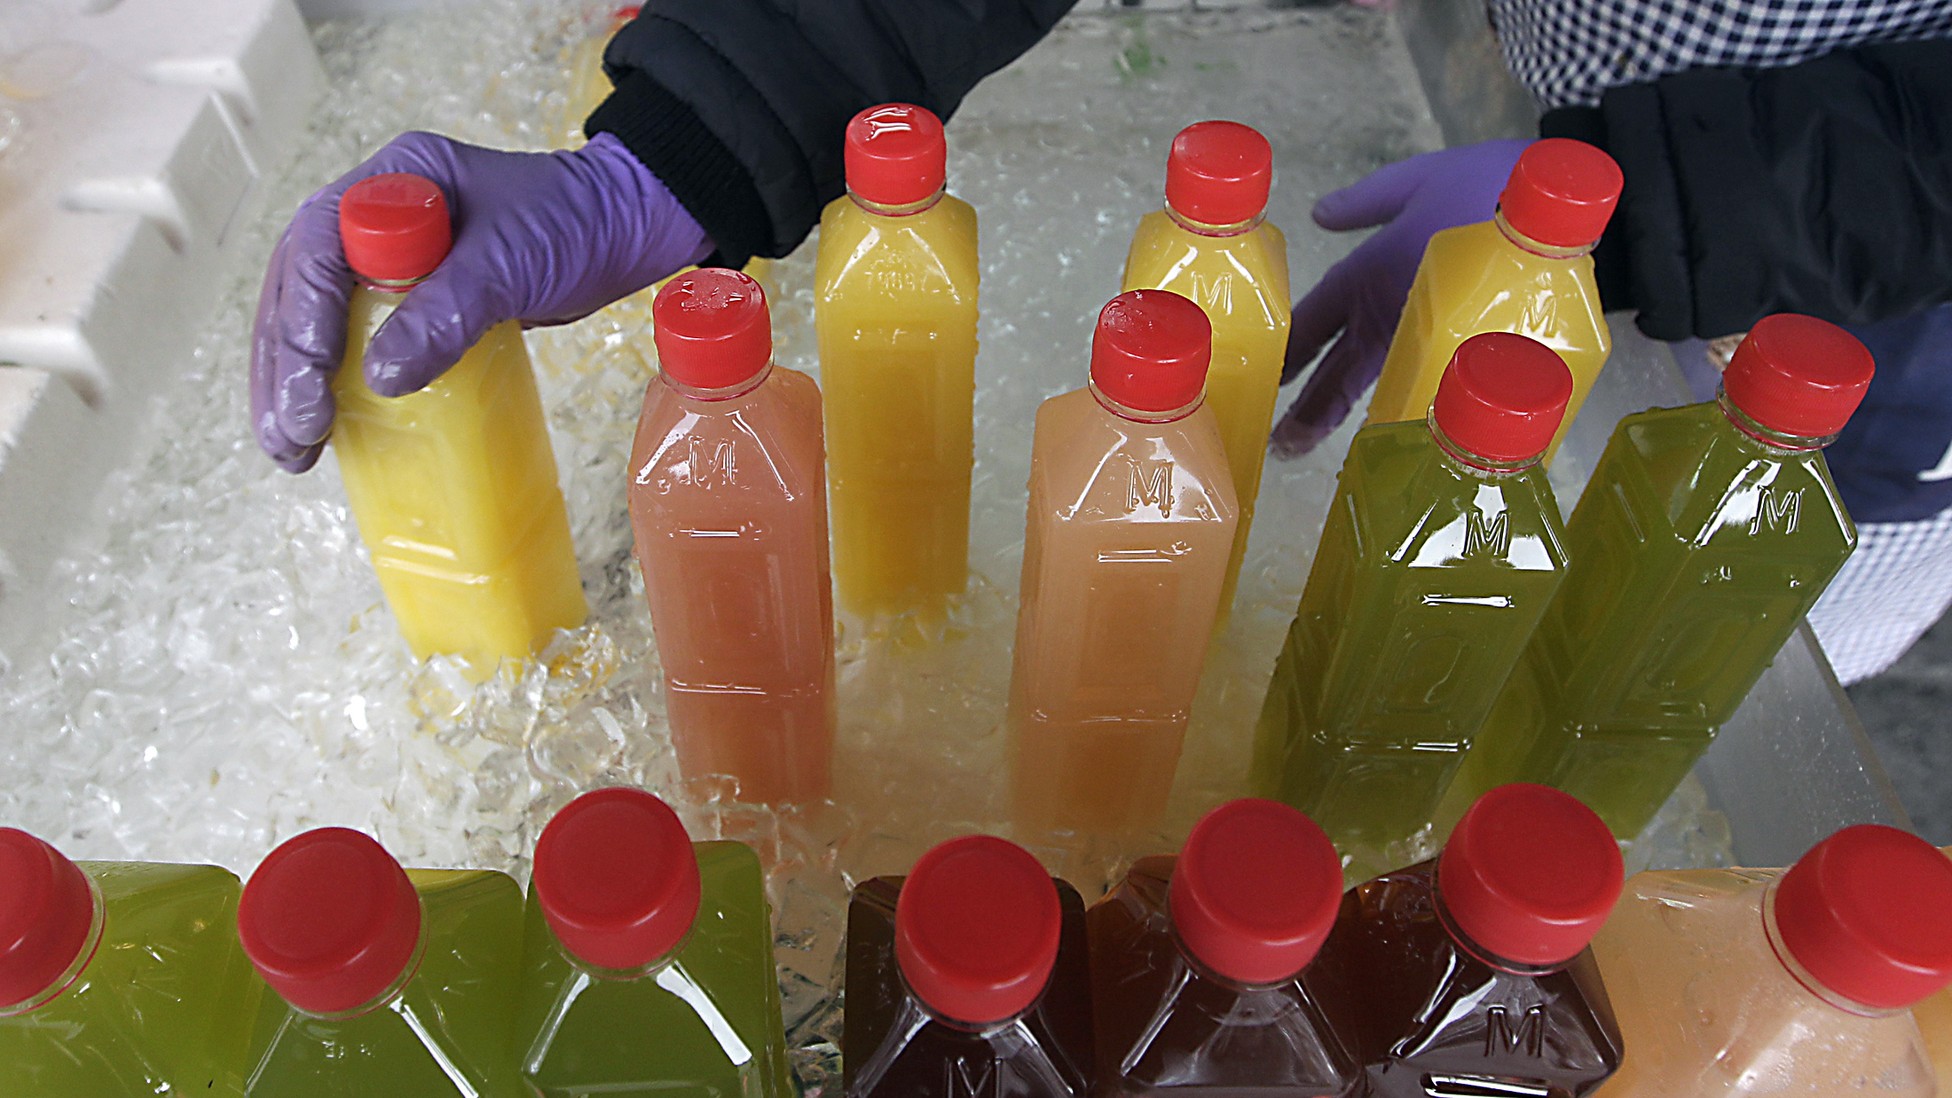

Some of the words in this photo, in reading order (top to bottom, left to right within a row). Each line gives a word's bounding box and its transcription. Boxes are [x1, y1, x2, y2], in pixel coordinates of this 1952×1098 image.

[1191, 271, 1232, 315] M
[1518, 295, 1557, 338] M
[688, 436, 738, 487] M
[1126, 459, 1173, 515] M
[1463, 511, 1510, 559] M
[1750, 487, 1804, 537] M
[1486, 1004, 1545, 1058] M
[944, 1055, 1004, 1098] M
